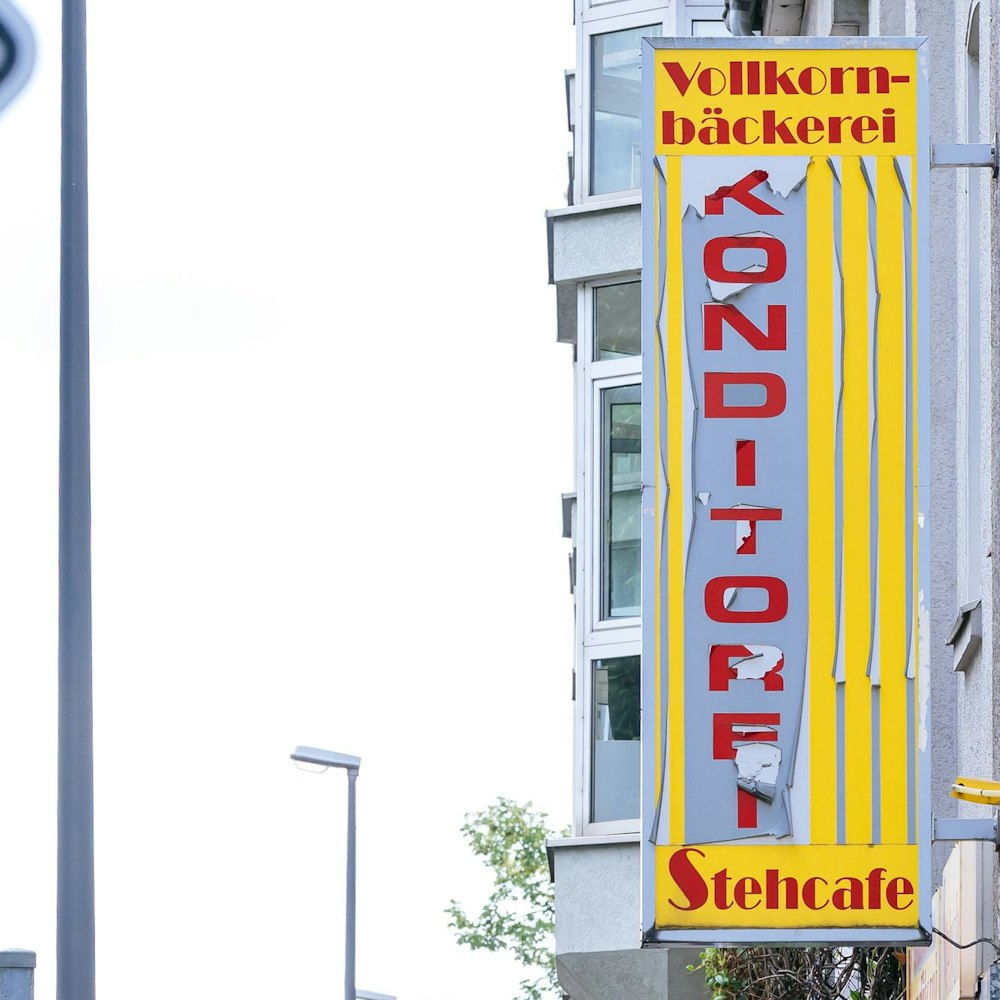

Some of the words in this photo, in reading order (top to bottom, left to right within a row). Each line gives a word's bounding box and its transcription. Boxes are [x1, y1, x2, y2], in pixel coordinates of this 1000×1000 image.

[662, 60, 911, 97] Vollkorn-
[661, 107, 896, 146] bäckerei
[668, 847, 915, 912] Stehcafe
